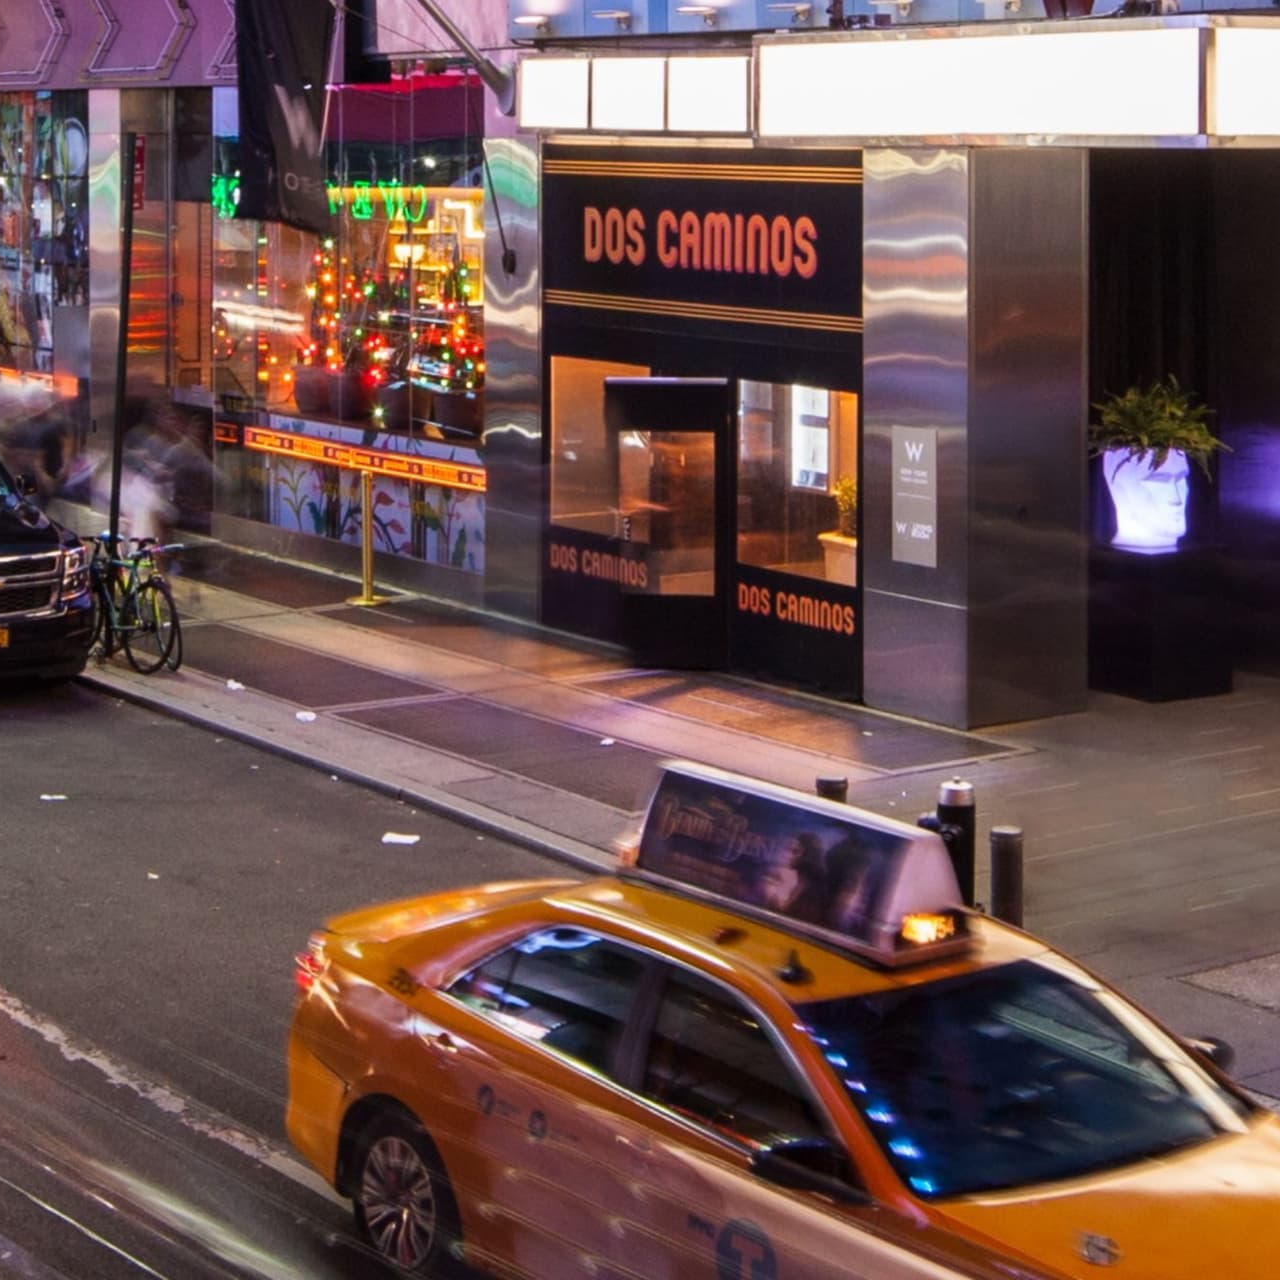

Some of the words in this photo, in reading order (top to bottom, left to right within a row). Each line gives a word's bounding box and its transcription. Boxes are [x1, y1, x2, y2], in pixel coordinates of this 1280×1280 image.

[583, 205, 647, 267] DOS
[656, 209, 818, 280] CAMINOS
[904, 441, 924, 462] W
[549, 543, 578, 574] DOS
[581, 548, 648, 589] CAMINOS
[737, 582, 771, 617] DOS
[775, 590, 856, 636] CAMINOS
